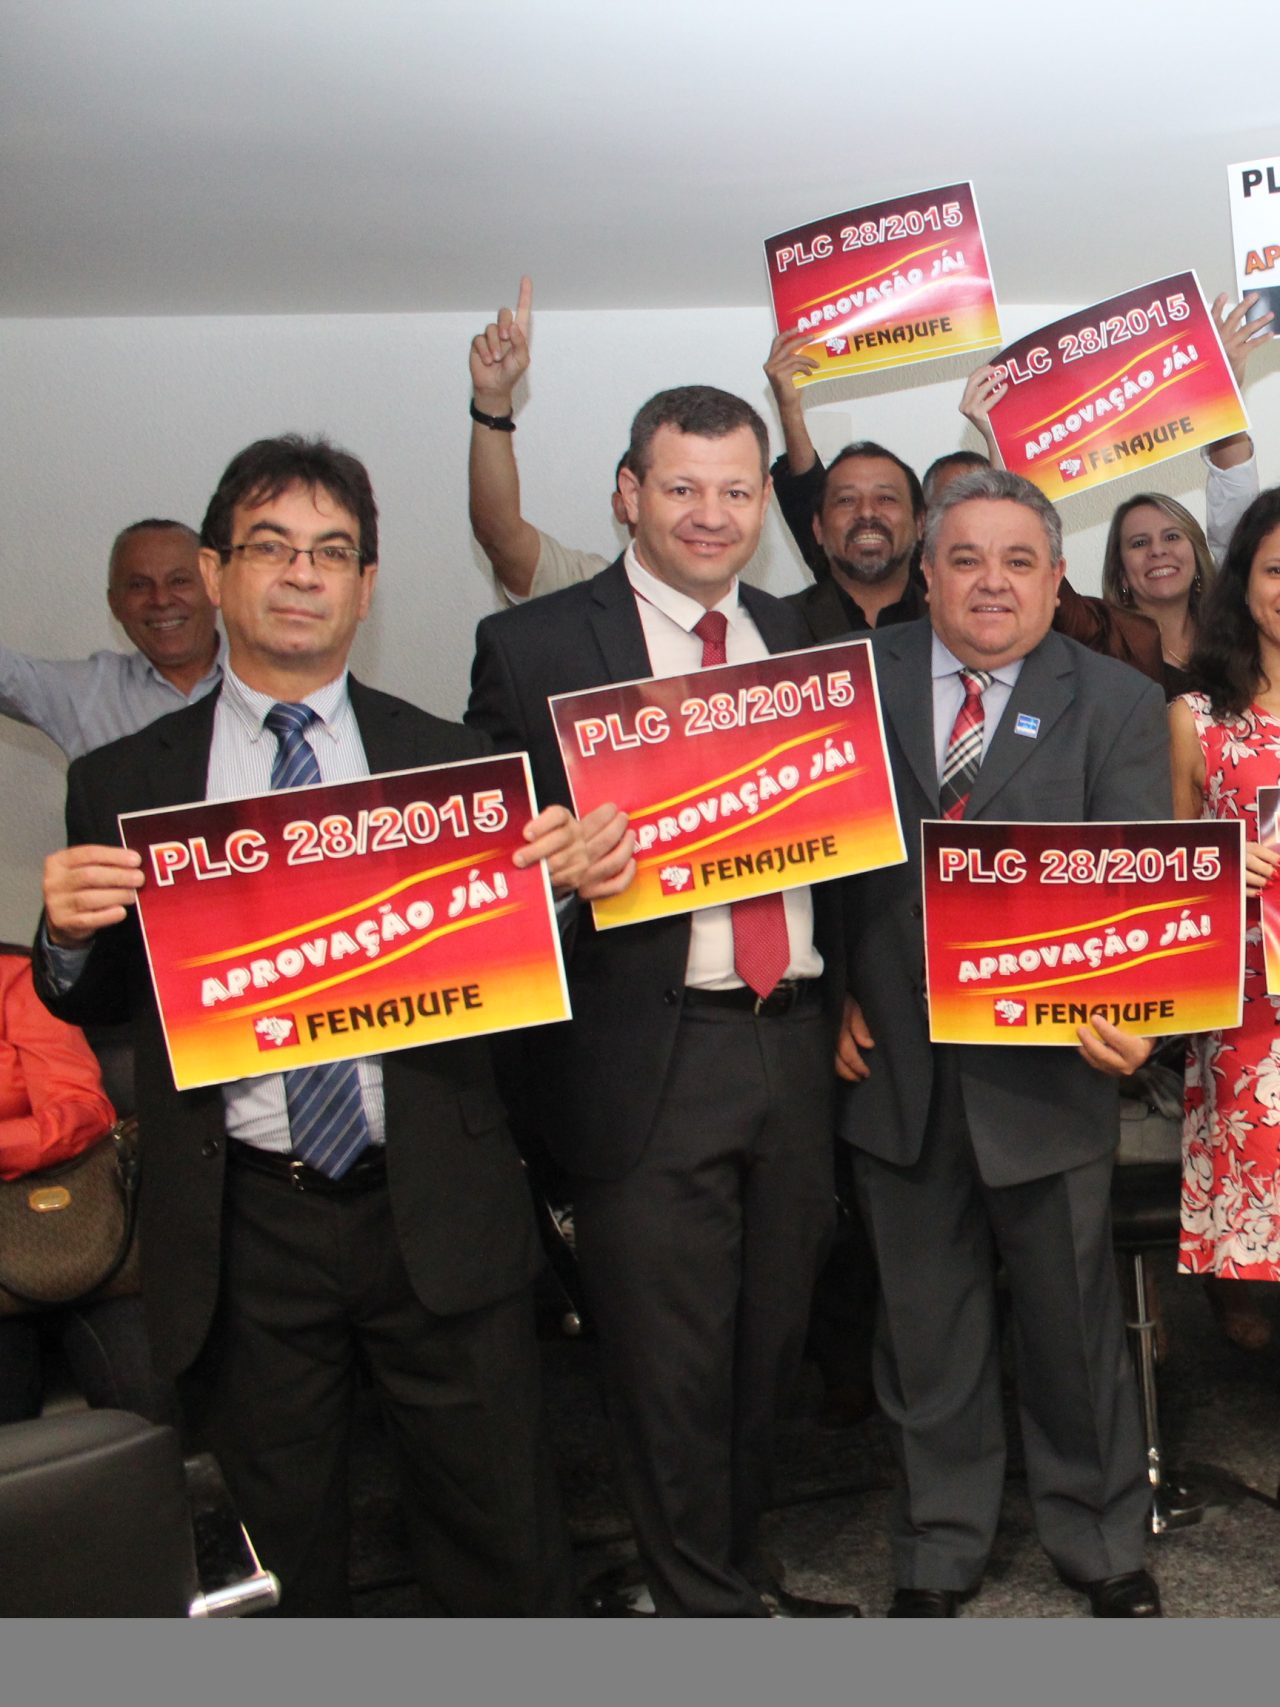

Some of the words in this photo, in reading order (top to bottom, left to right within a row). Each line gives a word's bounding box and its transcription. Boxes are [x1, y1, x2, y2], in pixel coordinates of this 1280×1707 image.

[775, 235, 833, 272] PLC
[840, 202, 963, 251] 28/2015
[797, 268, 923, 333] APROVAÇÃO
[931, 249, 966, 277] JÁ!
[853, 317, 952, 352] FENAJUFE
[1058, 293, 1190, 363] 28/2015
[1025, 370, 1155, 459] APROVAÇÃO
[1162, 344, 1198, 377] JÁ!
[1088, 416, 1194, 470] FENAJUFE
[574, 706, 670, 757] PLC
[681, 671, 855, 736] 28/2015
[633, 766, 799, 853] PROVAÇÃO
[809, 738, 856, 779] JÁ!
[149, 829, 269, 887] PLC
[283, 789, 508, 865] 28/2015
[700, 835, 838, 886] FENAJUFE
[939, 847, 1027, 883] PLC
[1040, 847, 1221, 884] 28/2015
[201, 903, 434, 1006] APROVAÇÃO
[448, 869, 508, 917] JÁ!
[958, 927, 1148, 982] APROVAÇÃO
[1159, 909, 1211, 946] JÁ!
[306, 984, 483, 1040] FENAJUFE
[1035, 1000, 1175, 1026] FENAJUFE
